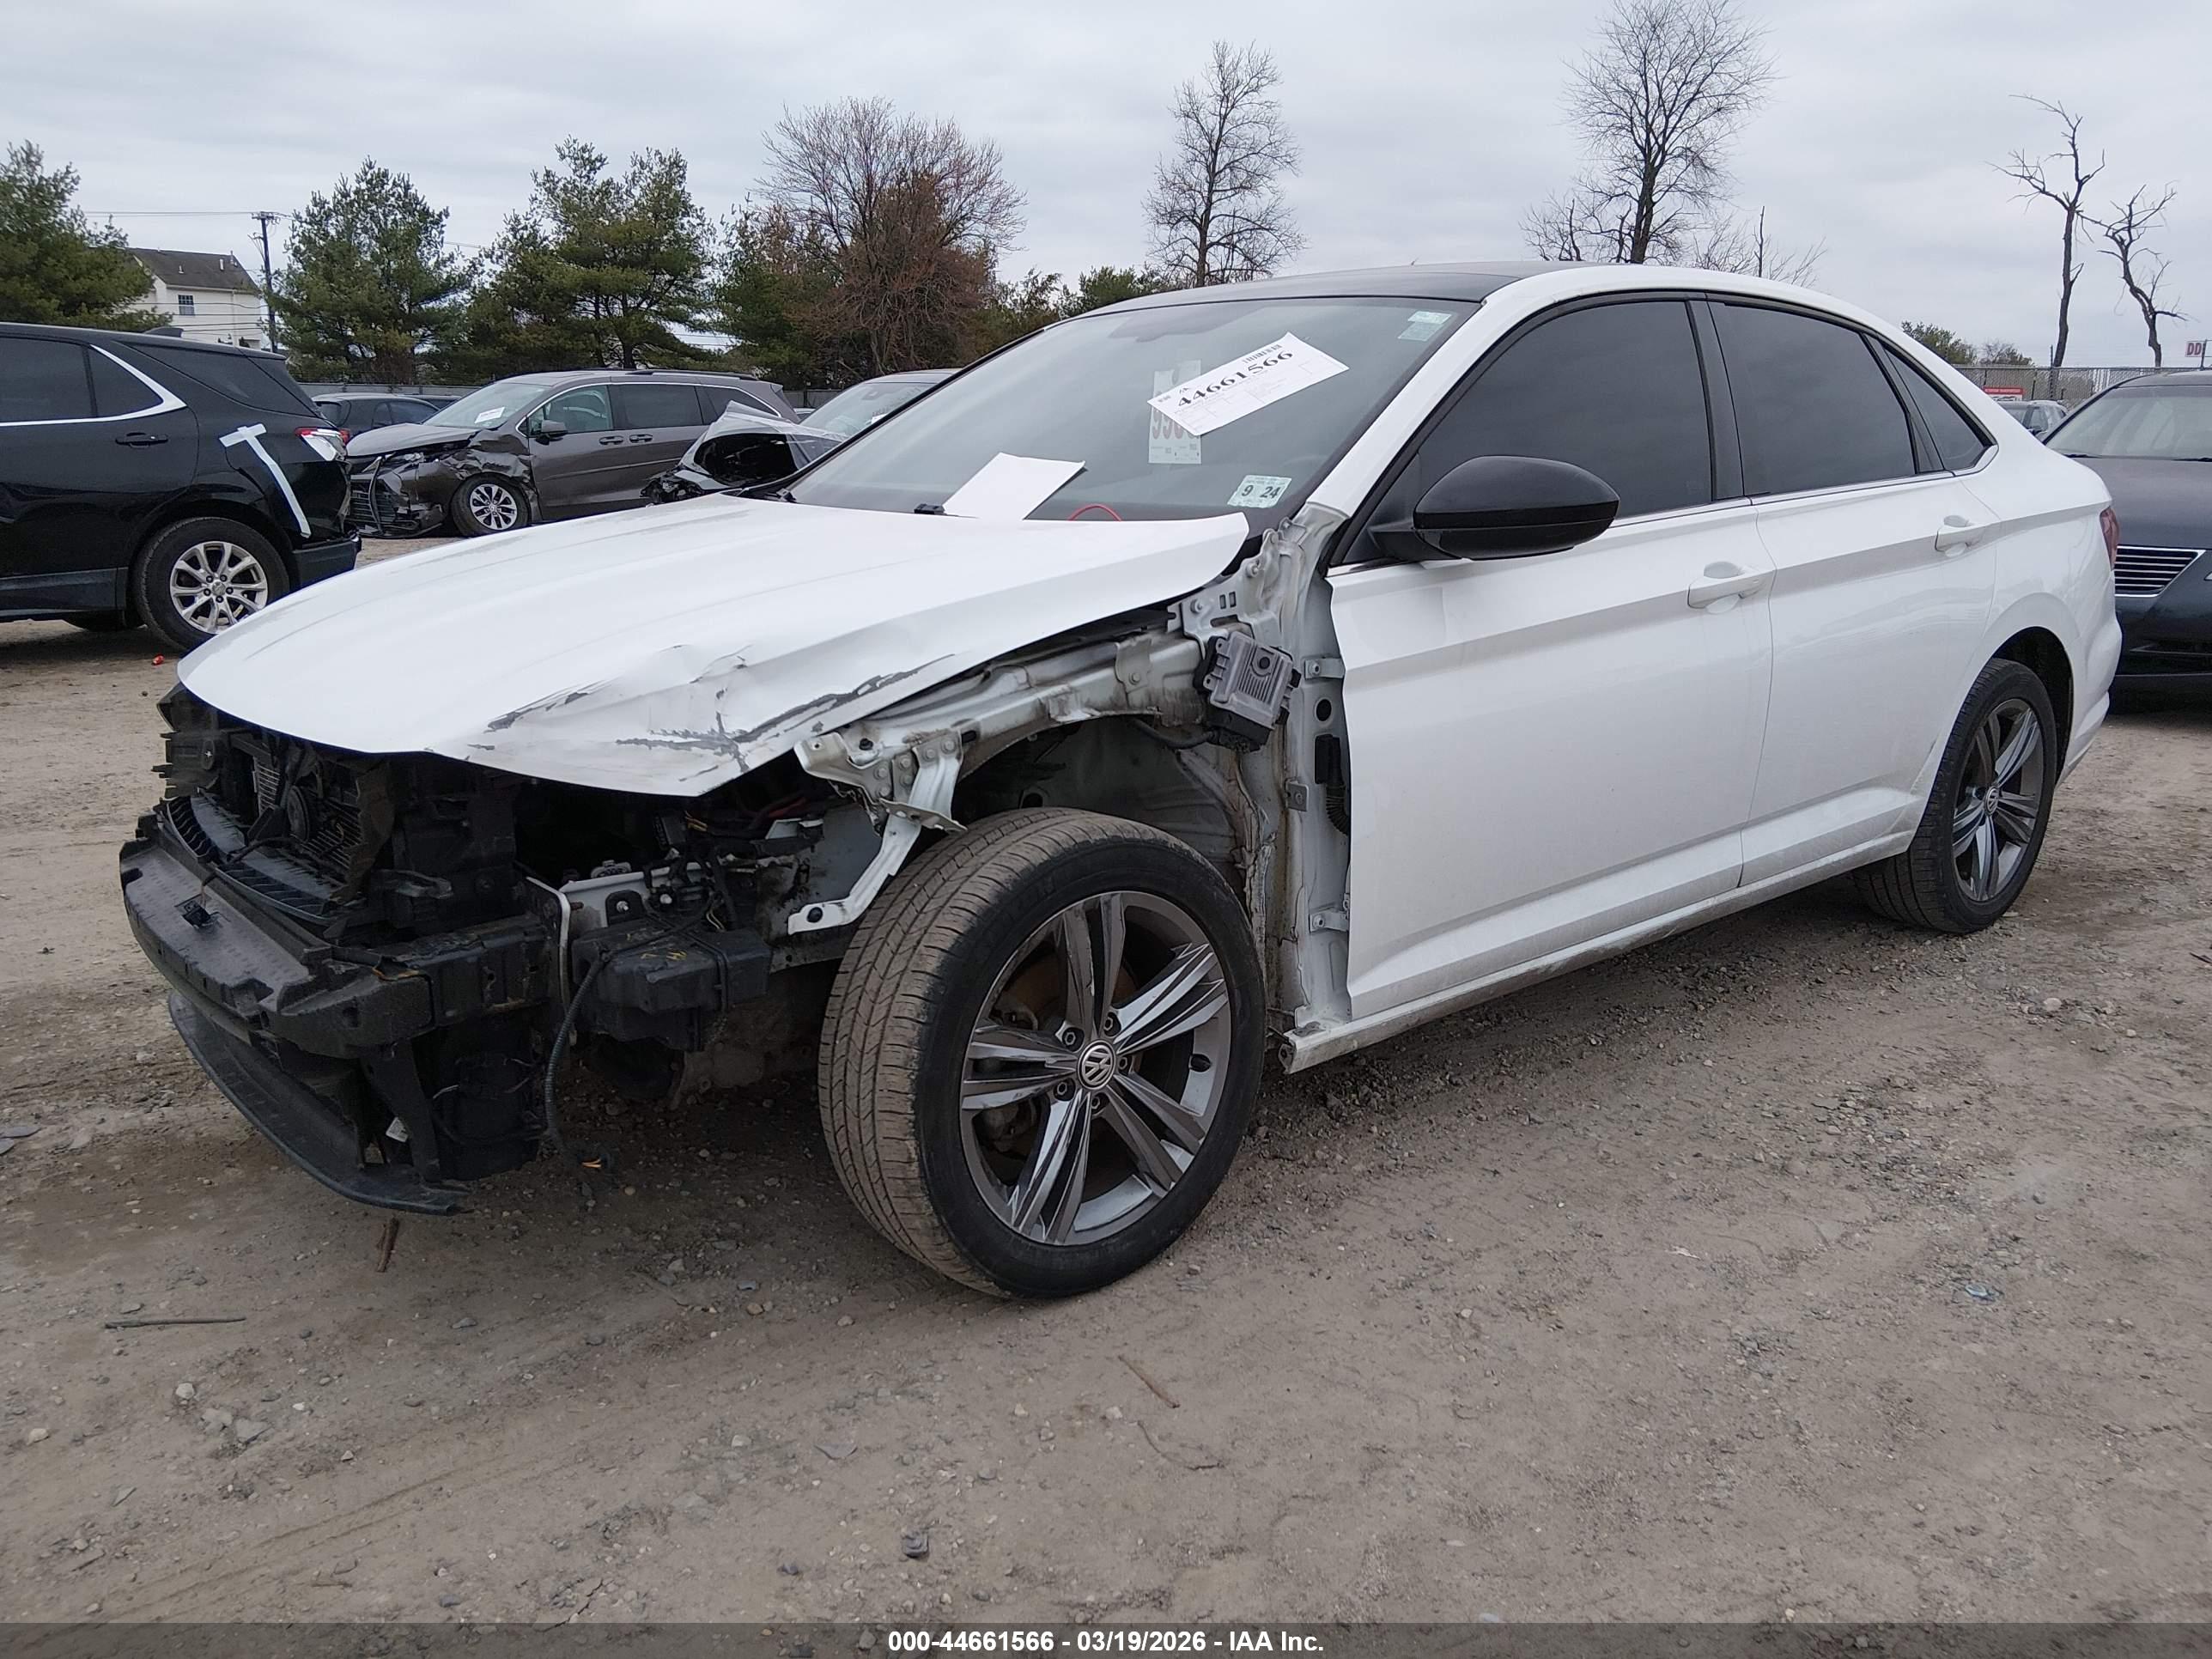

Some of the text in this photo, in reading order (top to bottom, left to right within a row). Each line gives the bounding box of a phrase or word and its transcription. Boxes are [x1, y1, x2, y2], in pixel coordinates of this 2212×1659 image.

[1178, 350, 1293, 406] 44661566
[1242, 484, 1281, 498] 9 24
